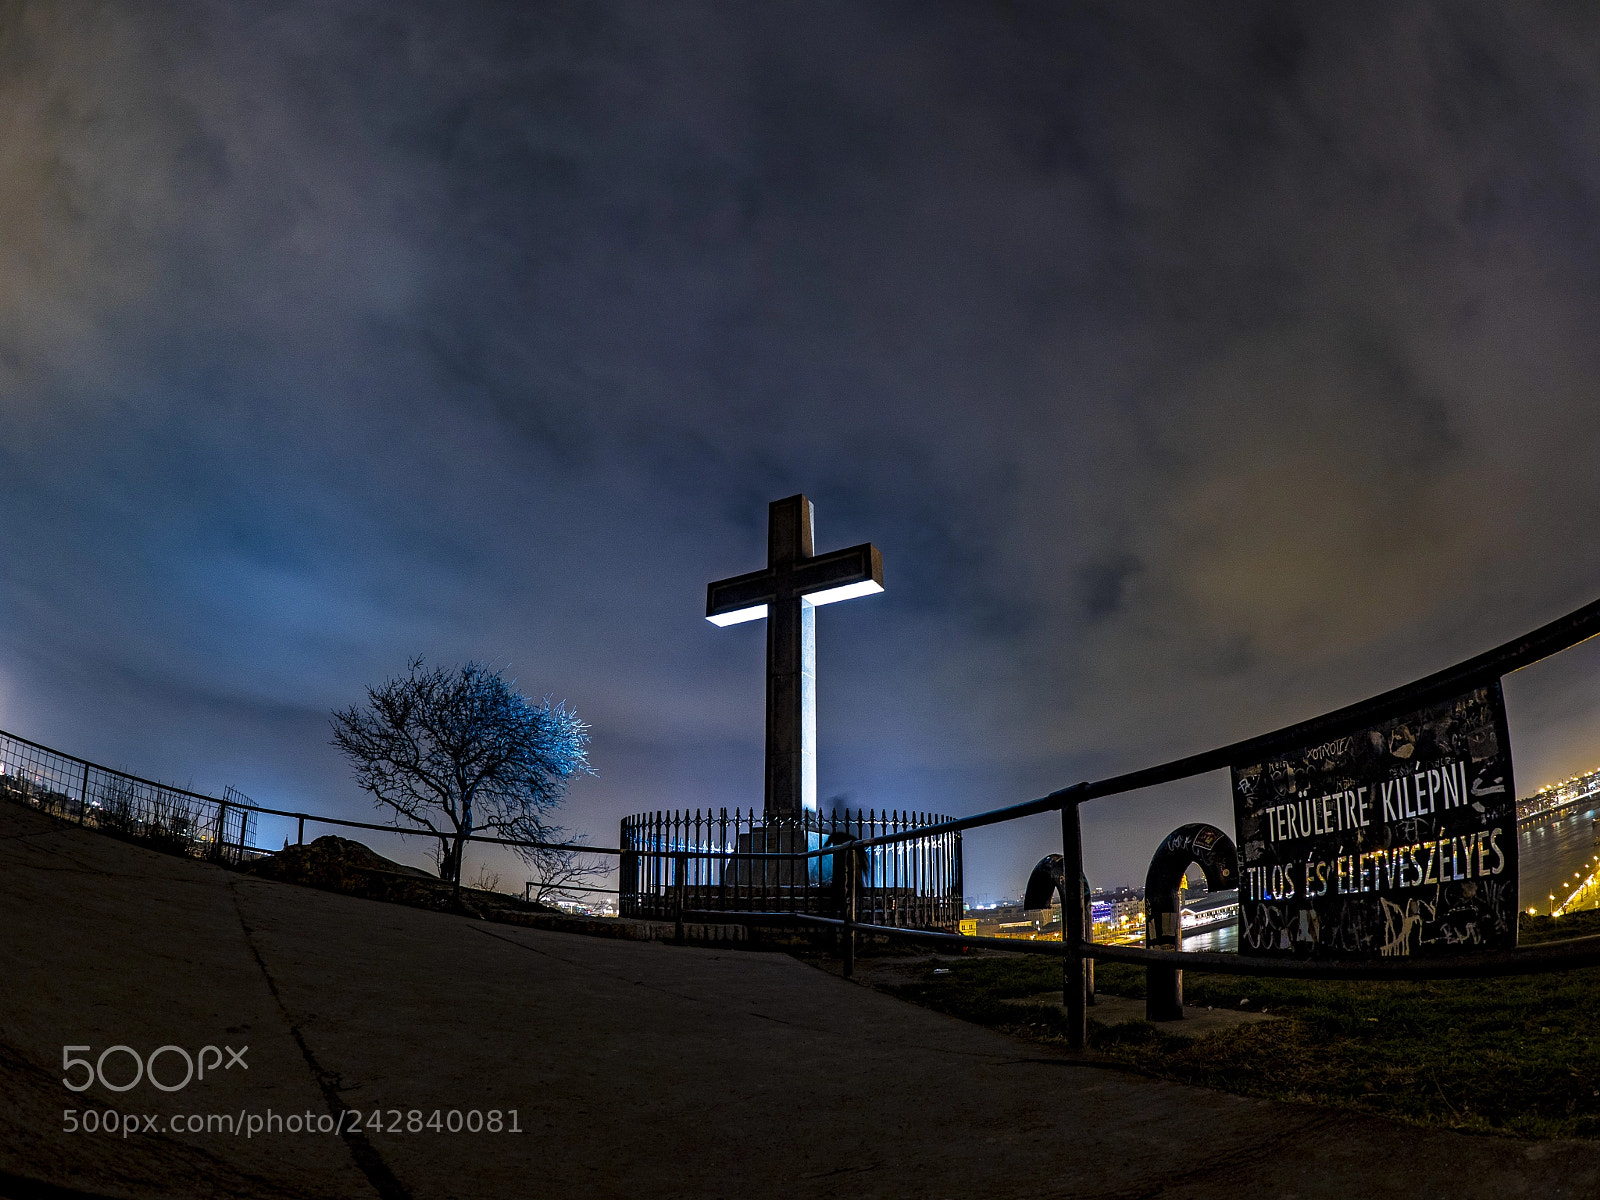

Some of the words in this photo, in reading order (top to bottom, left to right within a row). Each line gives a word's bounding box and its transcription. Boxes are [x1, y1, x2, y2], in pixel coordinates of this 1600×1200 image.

[1265, 786, 1370, 842] TERÜLETRE
[1381, 761, 1468, 822] KILÉPNI
[1246, 862, 1294, 901] TILOS
[1305, 851, 1327, 898] ÉS
[1336, 827, 1505, 895] ÉLETVESZÉLYES
